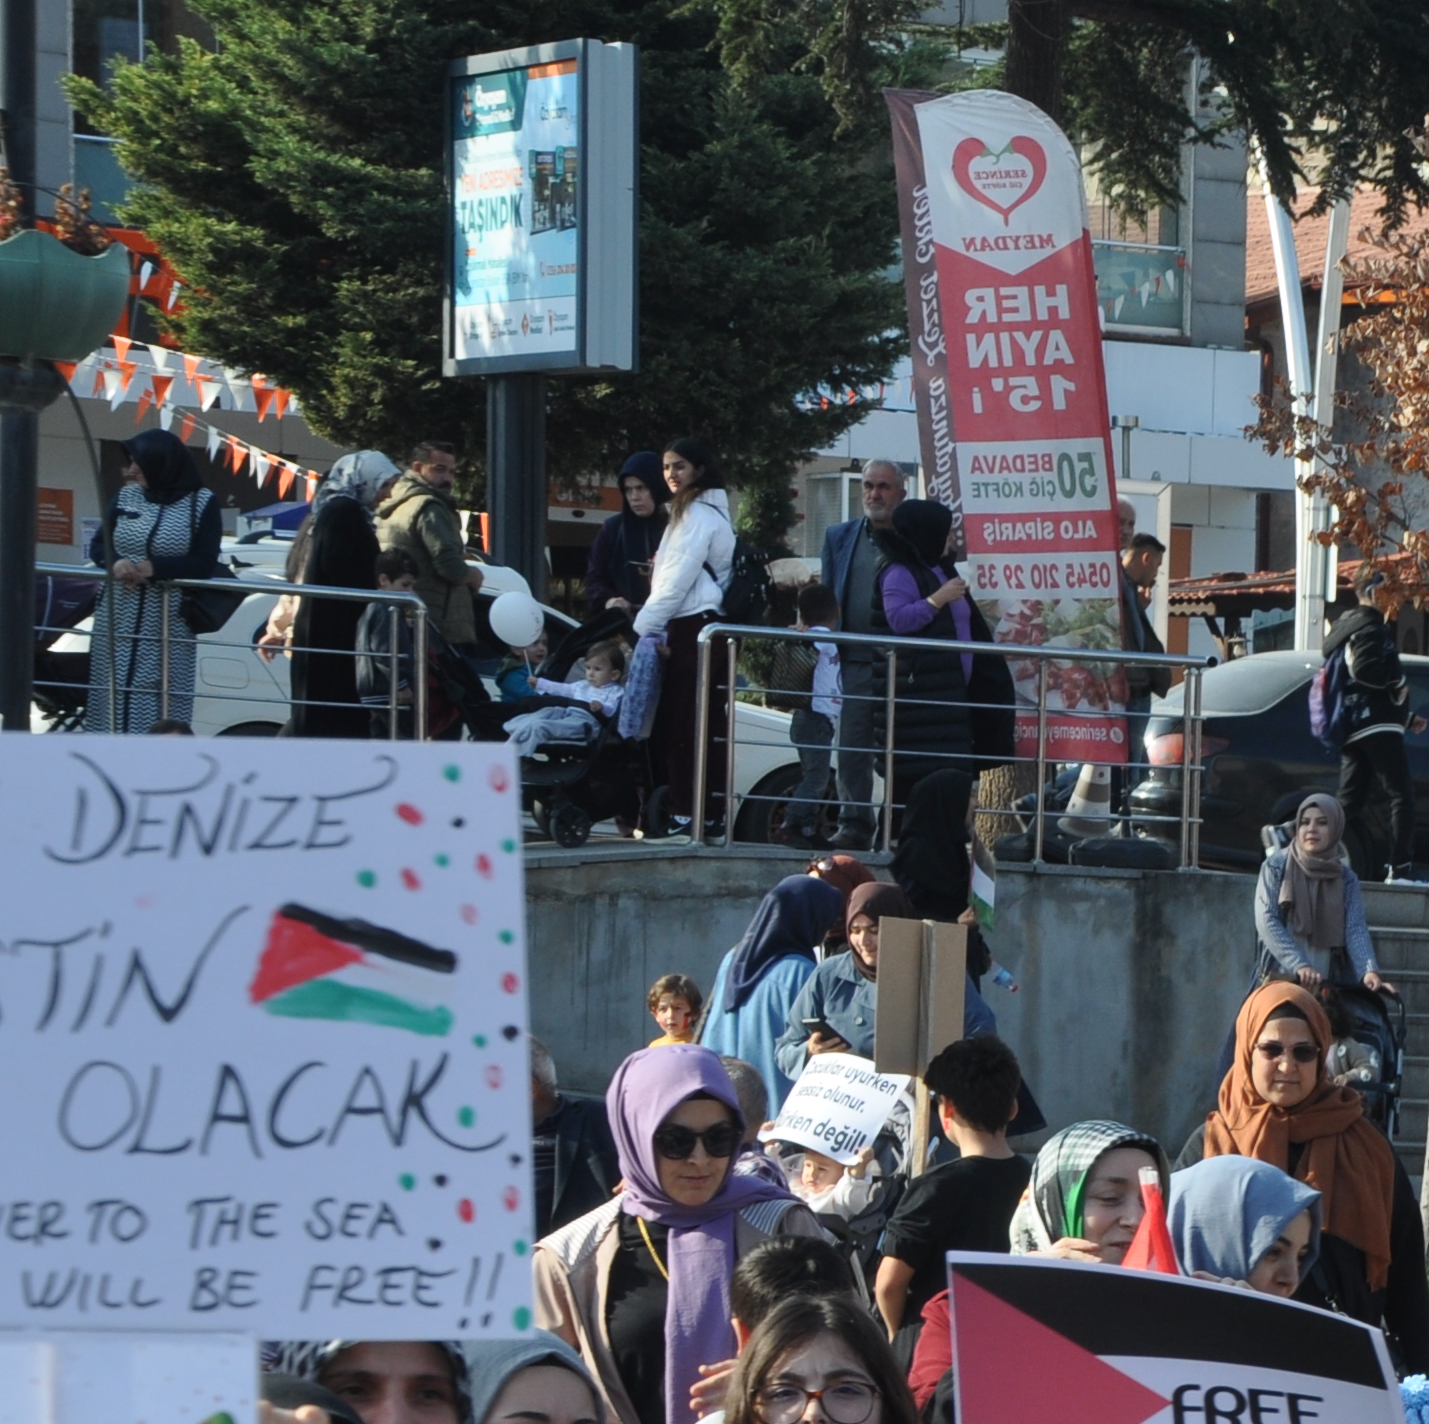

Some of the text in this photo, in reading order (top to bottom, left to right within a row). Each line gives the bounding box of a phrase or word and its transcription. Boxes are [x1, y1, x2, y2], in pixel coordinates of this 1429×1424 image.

[460, 193, 524, 243] TAŞINDIK
[43, 751, 399, 864] DENİZE
[0, 902, 252, 1033] TİN
[58, 1052, 508, 1160] OLACAK
[823, 1085, 866, 1114] olunur.
[845, 1066, 898, 1097] uyurken
[812, 1118, 868, 1155] değil!
[0, 1195, 407, 1251] ER TO THE SEA
[20, 1267, 162, 1313] WILL
[189, 1266, 262, 1313] BE
